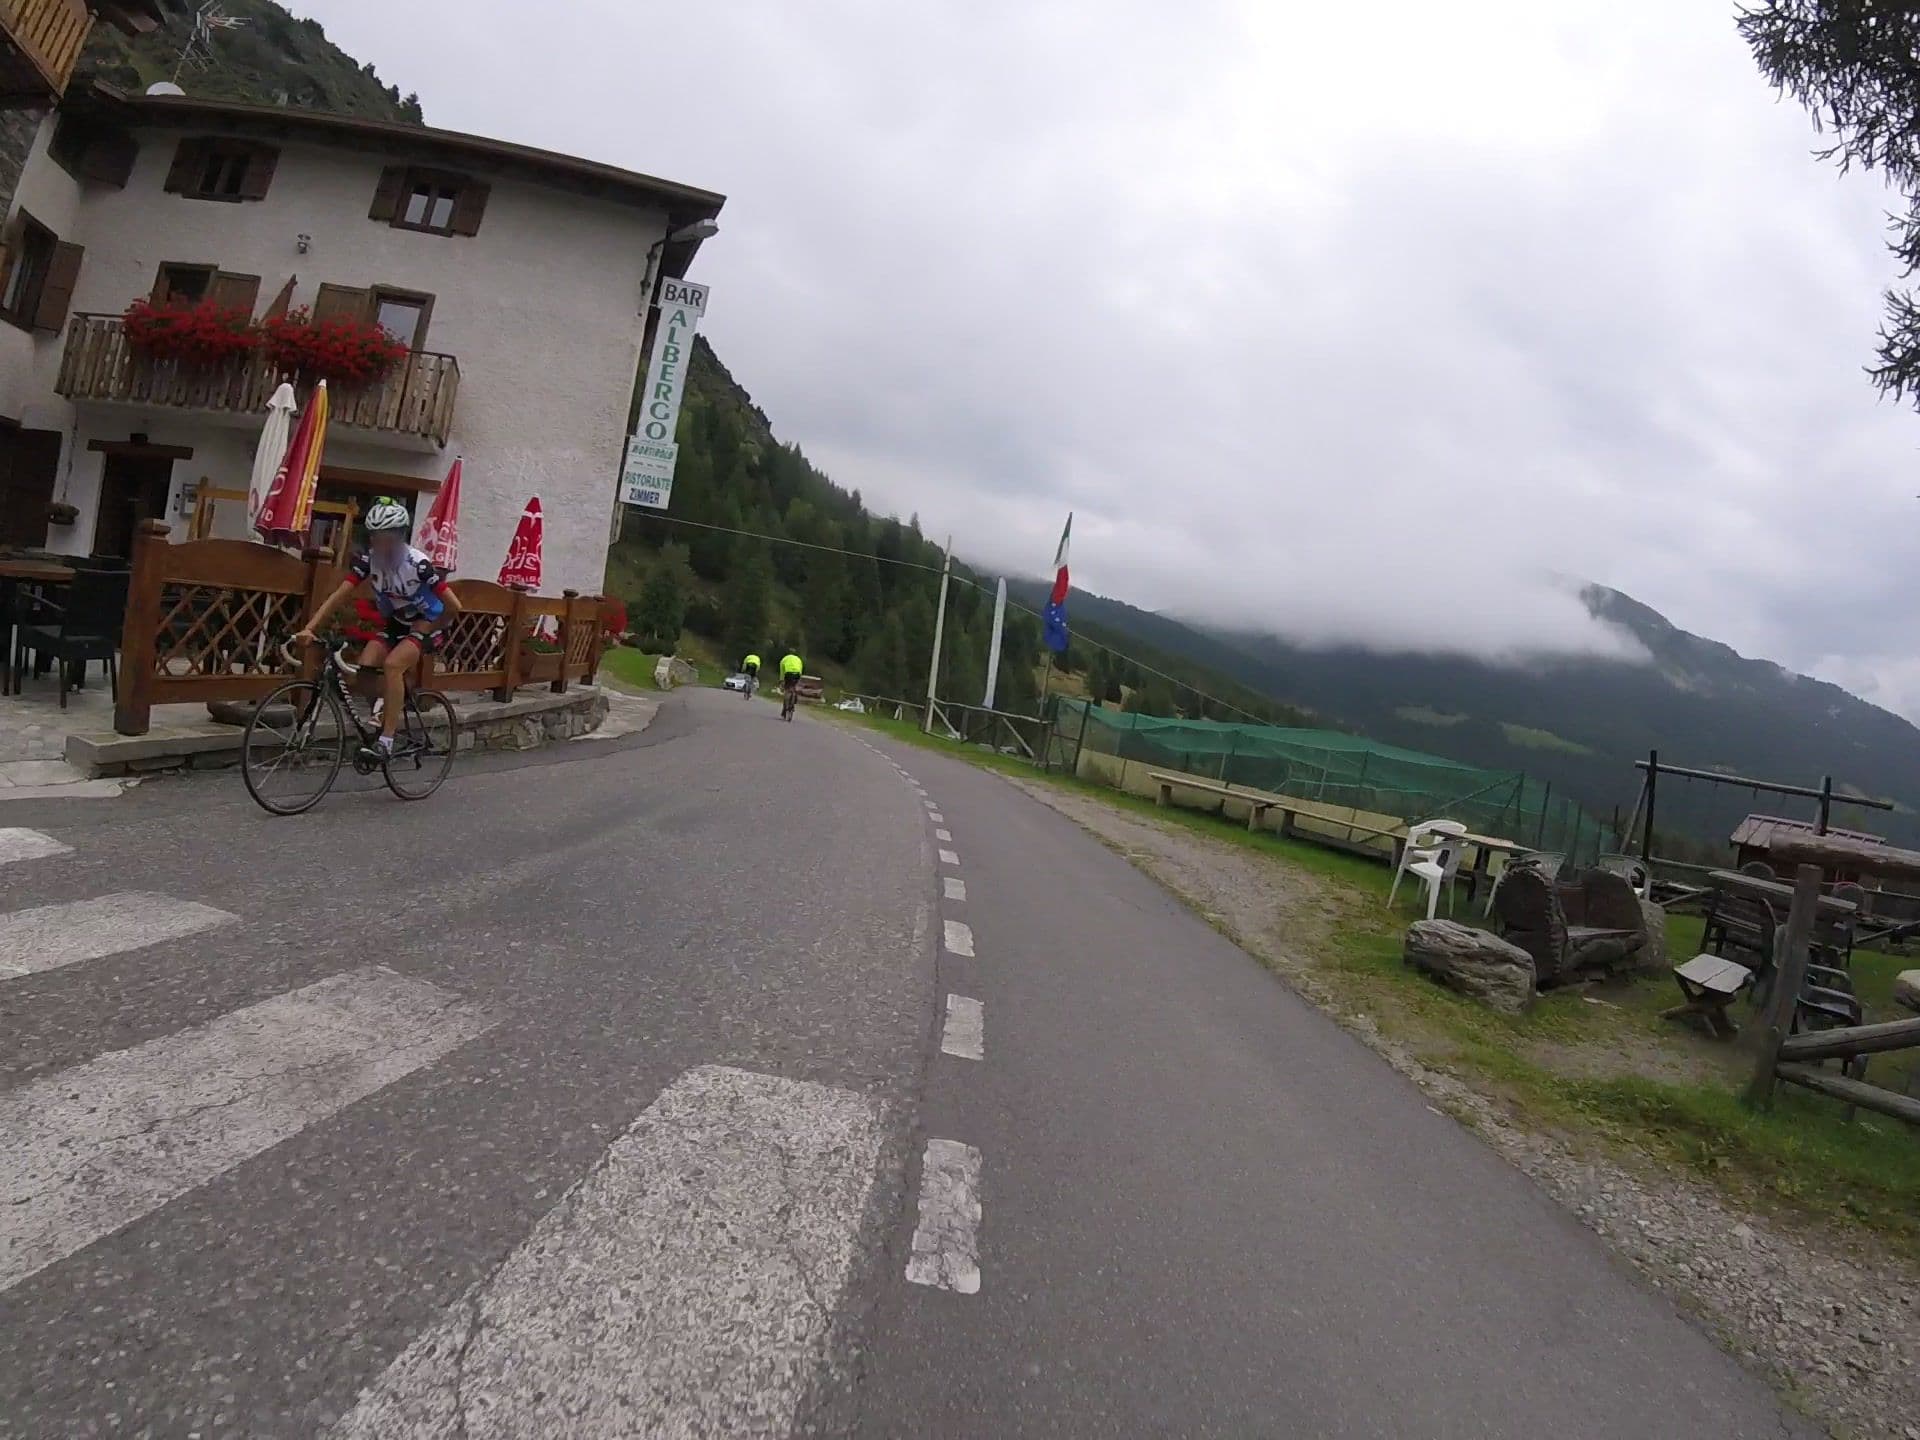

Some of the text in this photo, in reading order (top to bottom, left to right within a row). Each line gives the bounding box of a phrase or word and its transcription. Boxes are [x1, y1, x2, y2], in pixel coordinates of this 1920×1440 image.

[664, 283, 703, 307] BAR
[645, 309, 687, 441] ALBERGO
[629, 487, 660, 504] ZIMMER
